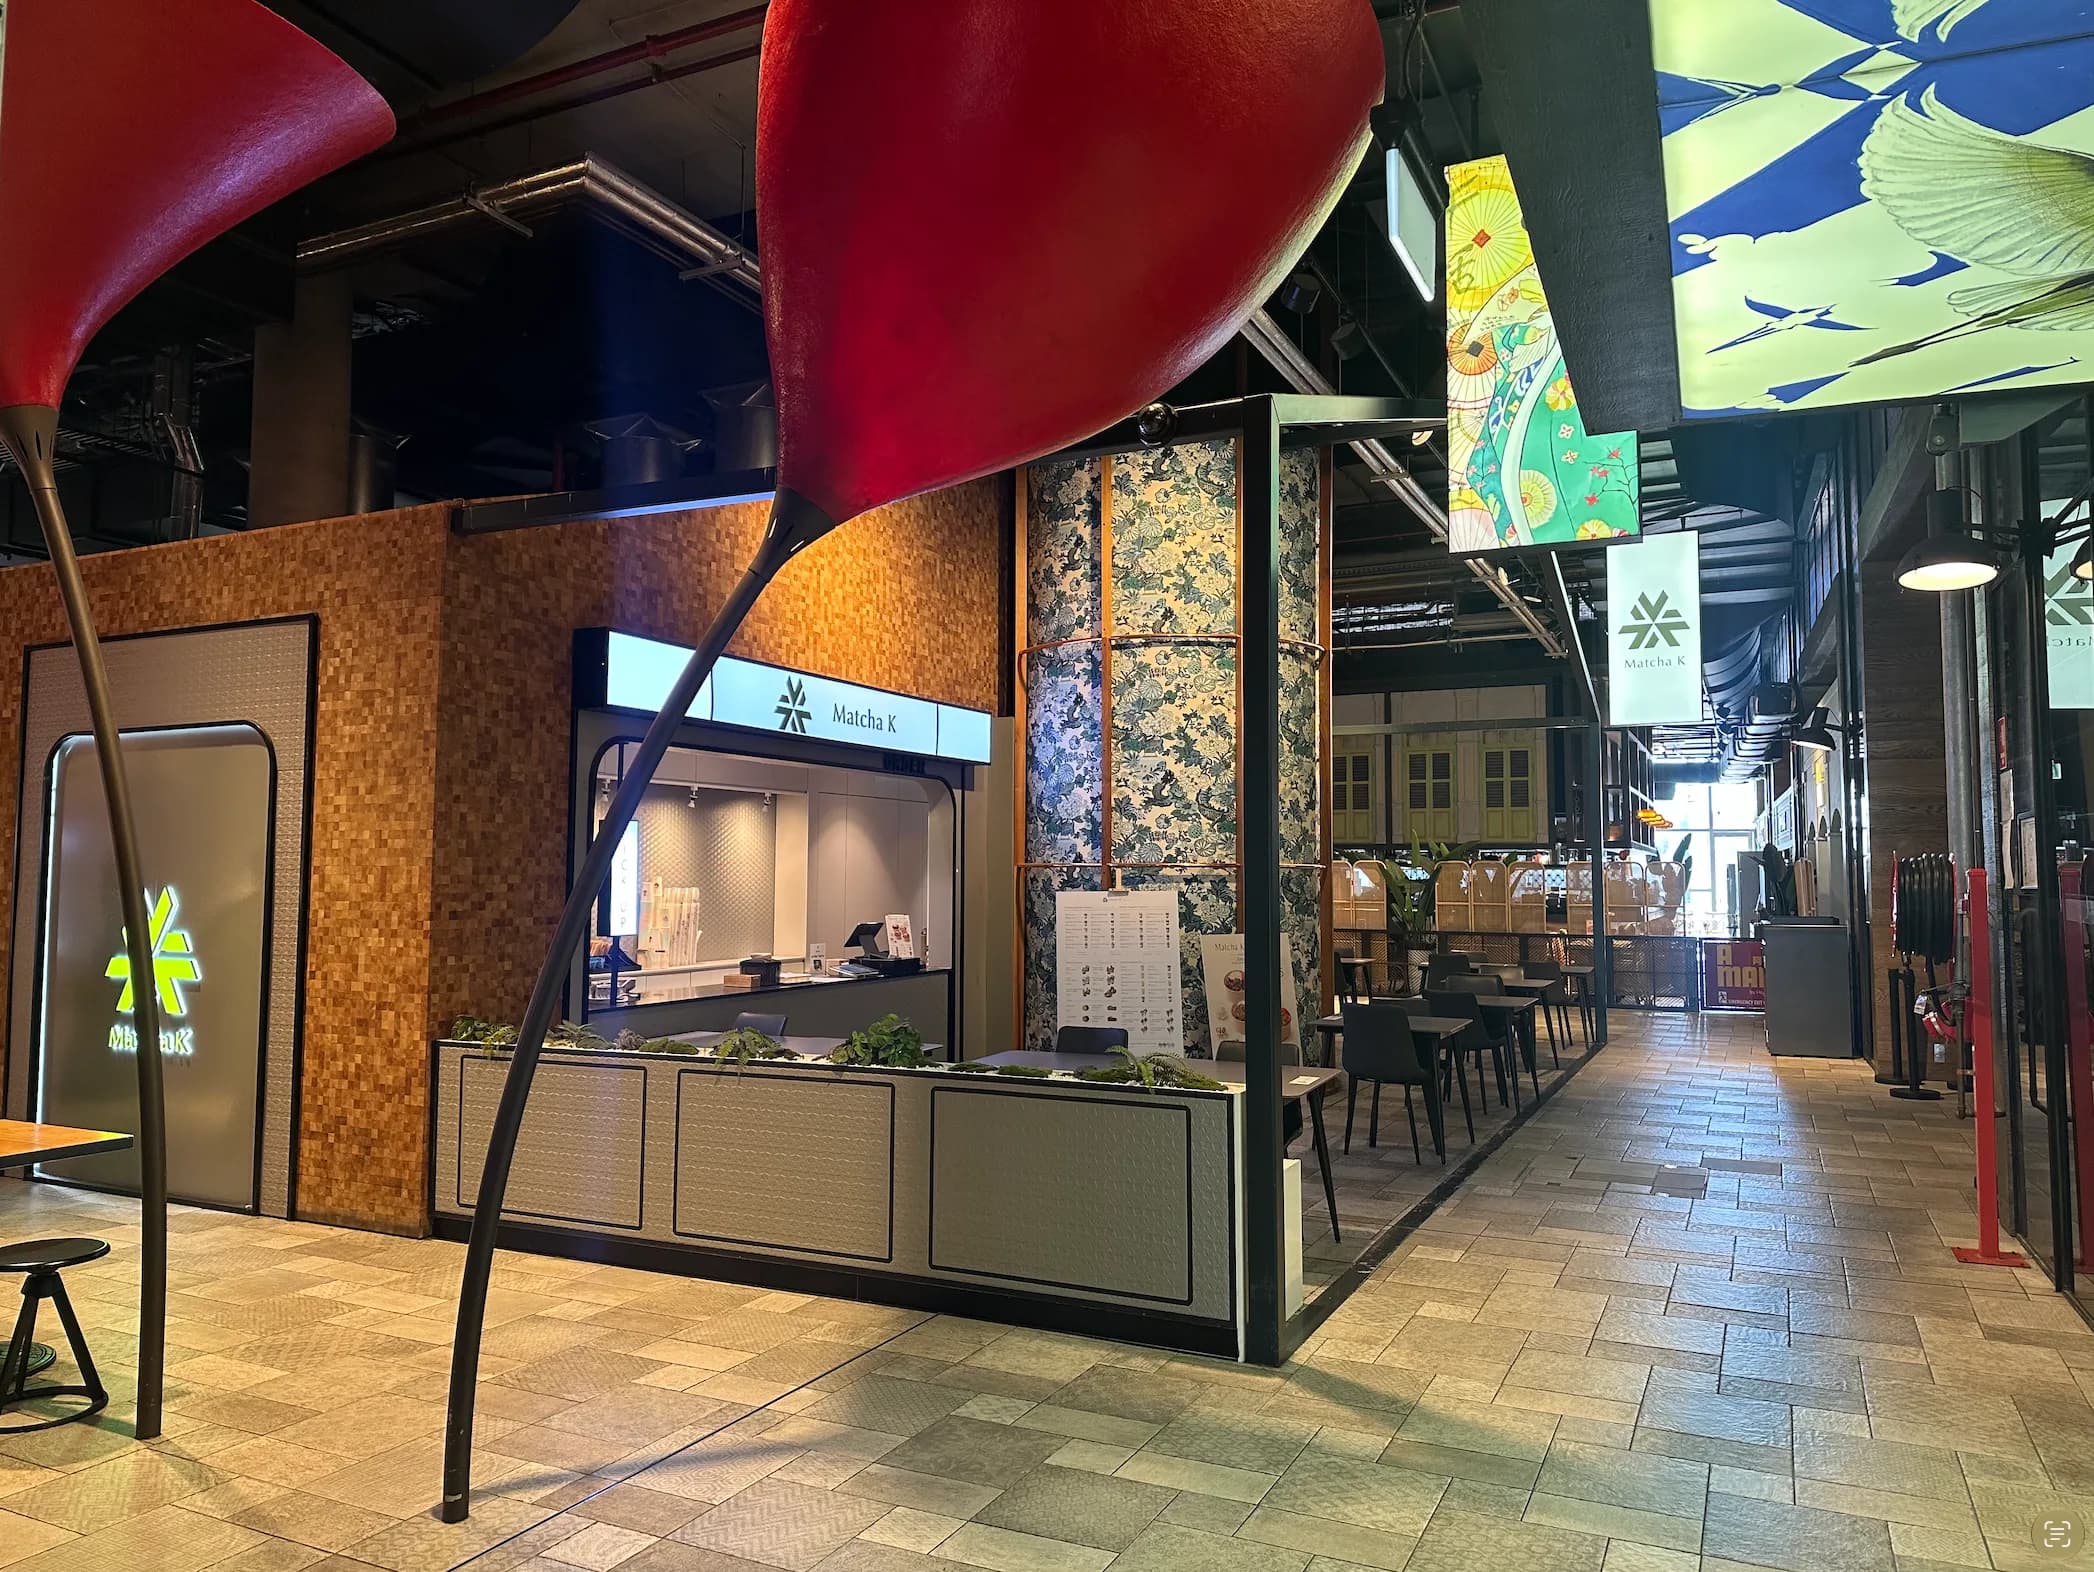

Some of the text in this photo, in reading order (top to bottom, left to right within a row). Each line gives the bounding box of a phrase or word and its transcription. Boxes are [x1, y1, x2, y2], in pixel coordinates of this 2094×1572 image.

[1624, 655, 1686, 669] Matcha K
[832, 702, 897, 733] Matcha K
[1717, 944, 1732, 965] A
[107, 1026, 193, 1055] Maa K
